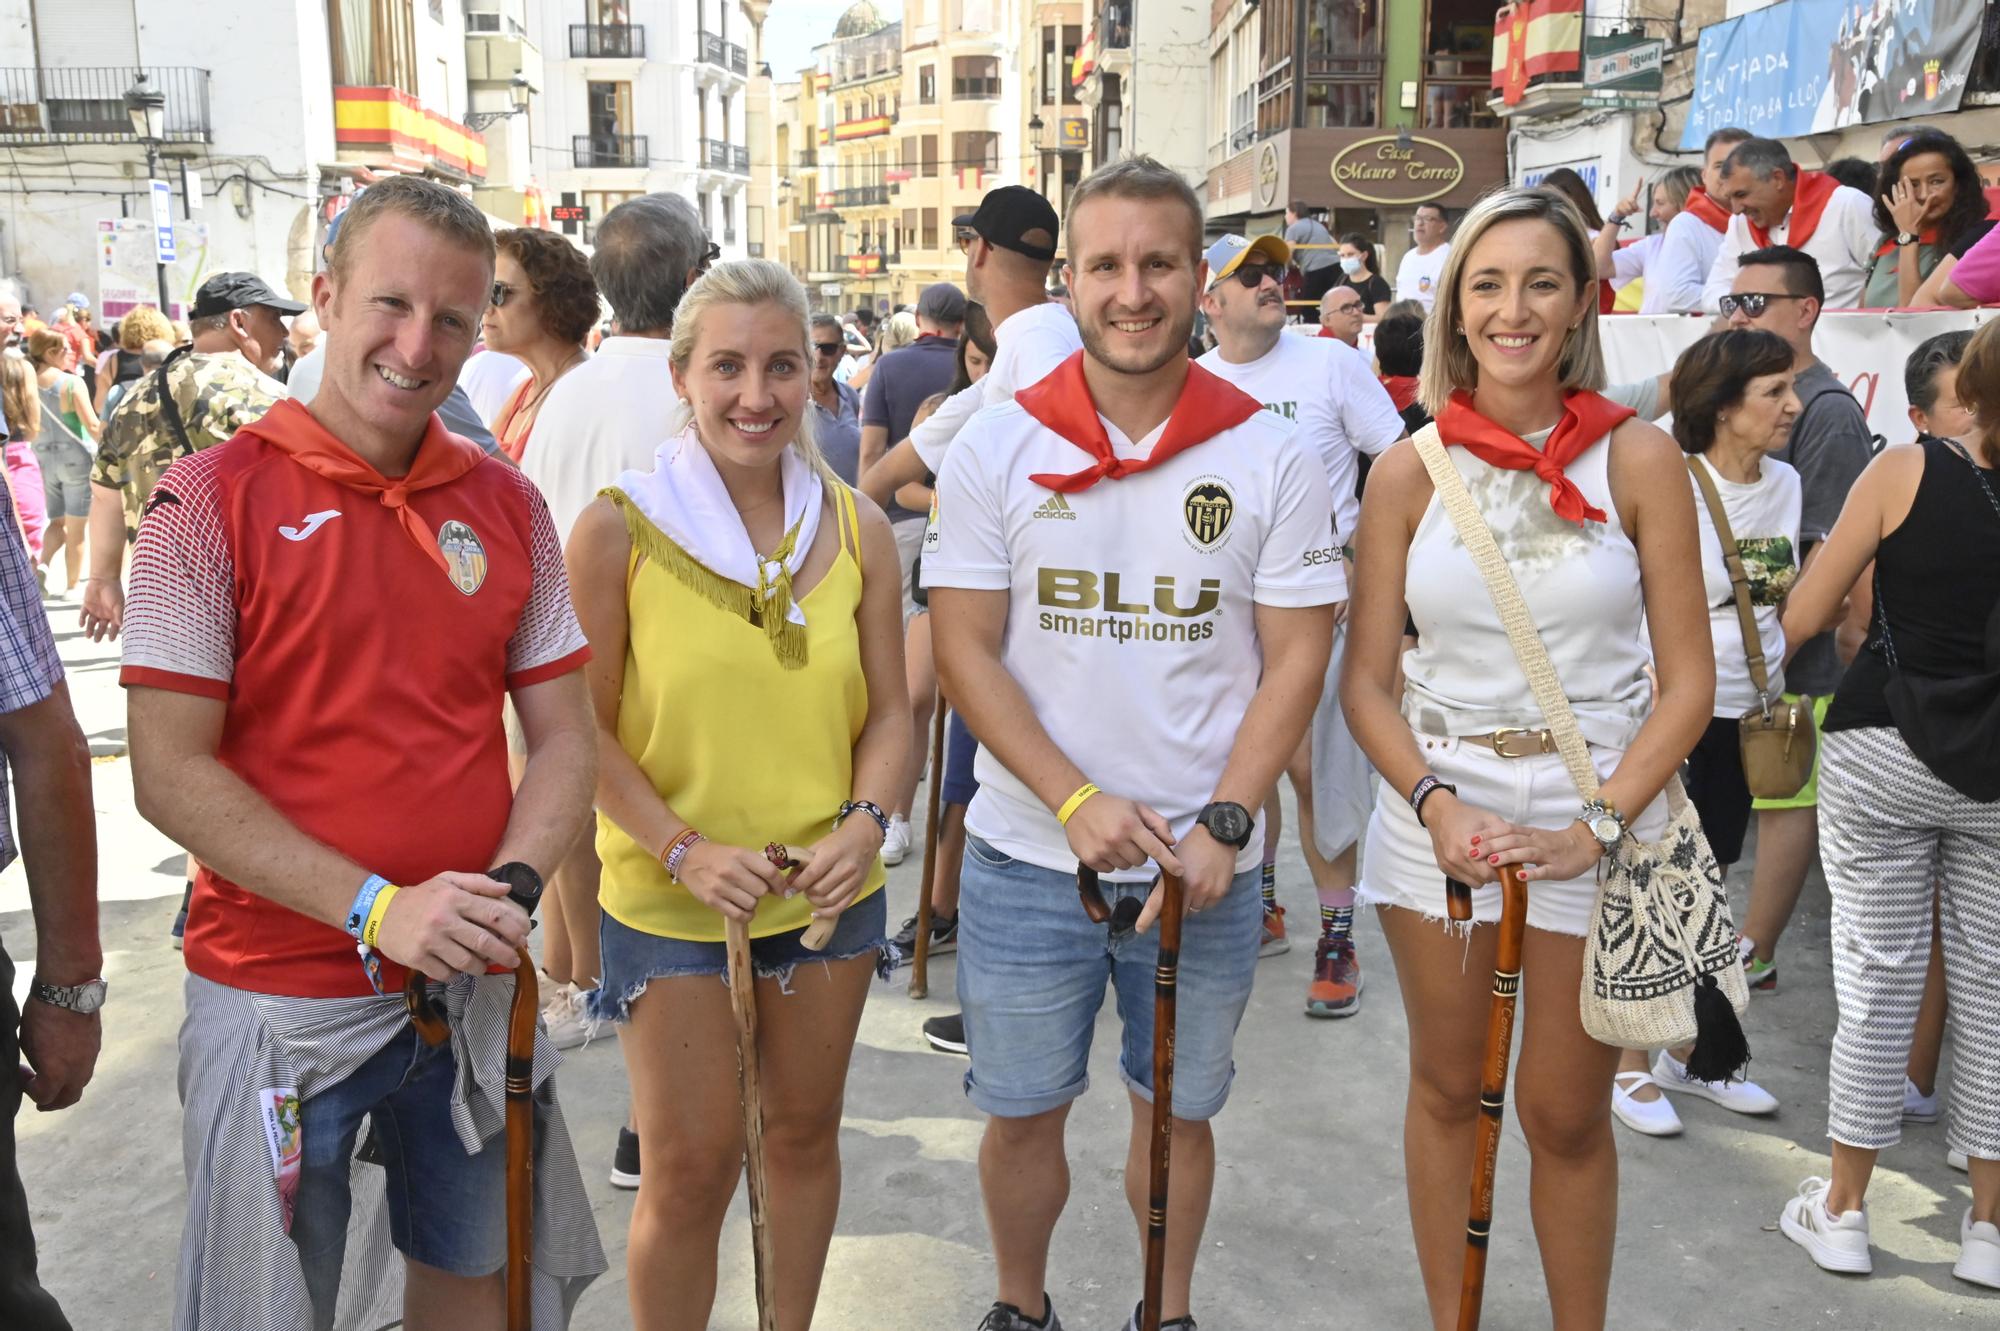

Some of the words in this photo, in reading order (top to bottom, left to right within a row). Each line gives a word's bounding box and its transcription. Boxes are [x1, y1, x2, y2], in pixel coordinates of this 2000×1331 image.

[1749, 75, 1820, 126] CABALLOS
[1376, 143, 1414, 161] Casa
[1336, 162, 1397, 180] Mauro
[1404, 161, 1458, 180] Torres
[1033, 509, 1077, 521] adidas
[1039, 611, 1214, 644] smartphones
